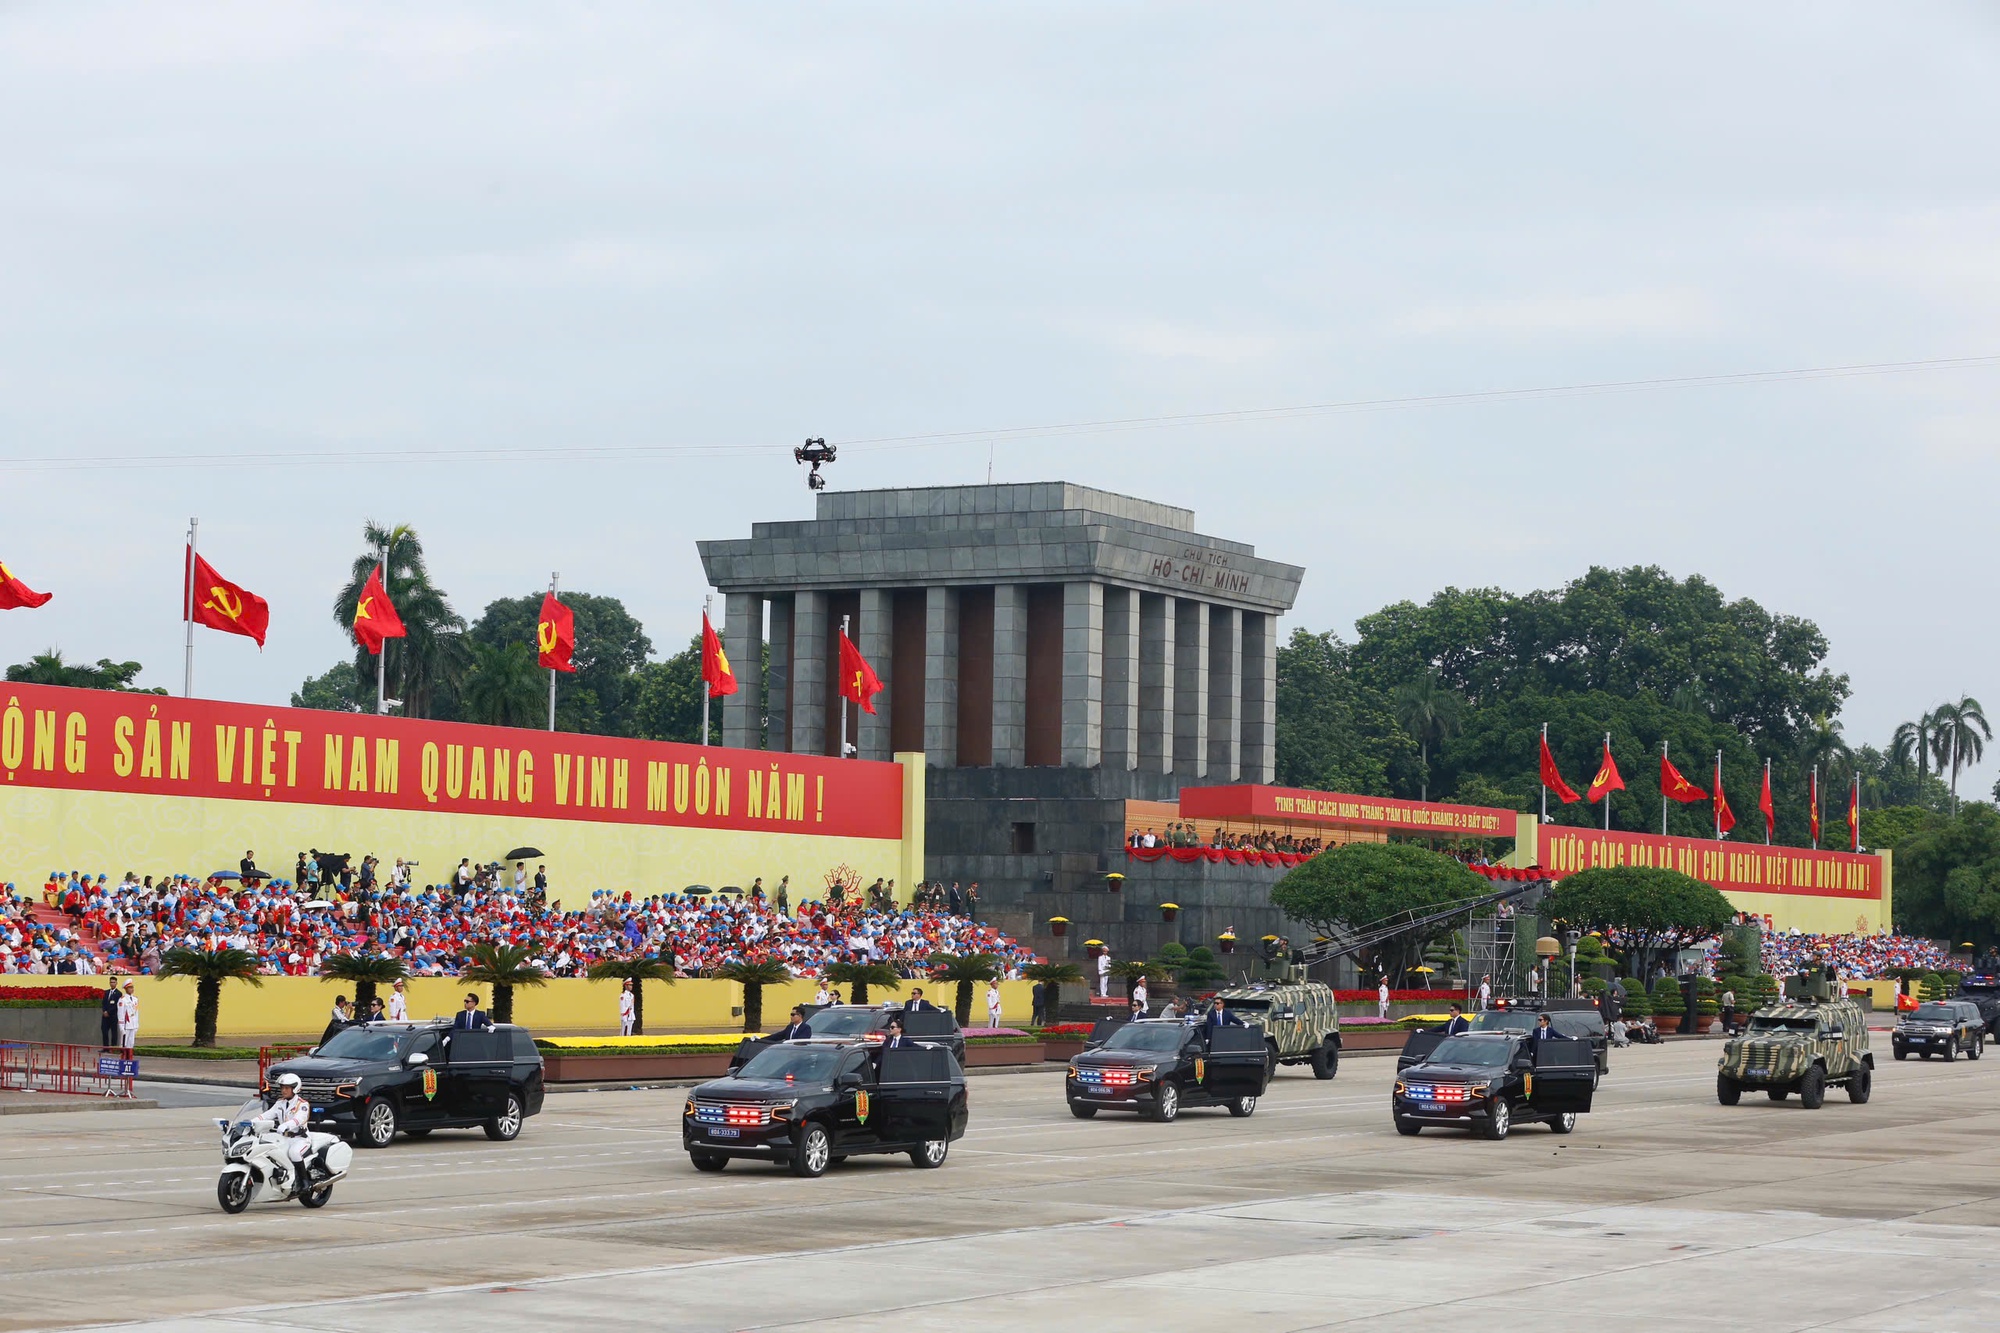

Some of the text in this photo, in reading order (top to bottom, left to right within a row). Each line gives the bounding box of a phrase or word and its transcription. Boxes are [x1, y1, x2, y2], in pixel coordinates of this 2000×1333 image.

[113, 704, 191, 780] SẢN
[215, 719, 302, 797] VIỆT
[323, 734, 400, 794] NAM
[421, 741, 534, 803] QUANG
[553, 752, 629, 809] VINH
[646, 756, 731, 816] MUÔN
[747, 763, 805, 821] NĂM
[1275, 796, 1294, 813] TINH
[1318, 798, 1337, 817] CÁCH
[1338, 802, 1360, 820] MẠNG
[1360, 803, 1384, 821] THÁNG
[1385, 805, 1401, 822] TÁM
[1402, 806, 1411, 823] VÀ
[1412, 806, 1430, 825] QUỐC
[1431, 809, 1454, 827] KHÁNH
[1468, 811, 1481, 829] BẤT
[1550, 833, 1585, 873] NƯỚC
[1630, 840, 1653, 869] HÒA
[1658, 843, 1673, 869] XÃ
[1703, 844, 1725, 882] CHỦ
[1729, 850, 1761, 884] NGHĨA
[1766, 852, 1788, 890] VIỆT
[1791, 858, 1812, 887] NAM
[1816, 857, 1843, 889] MUÔN
[1846, 858, 1865, 891] NĂM
